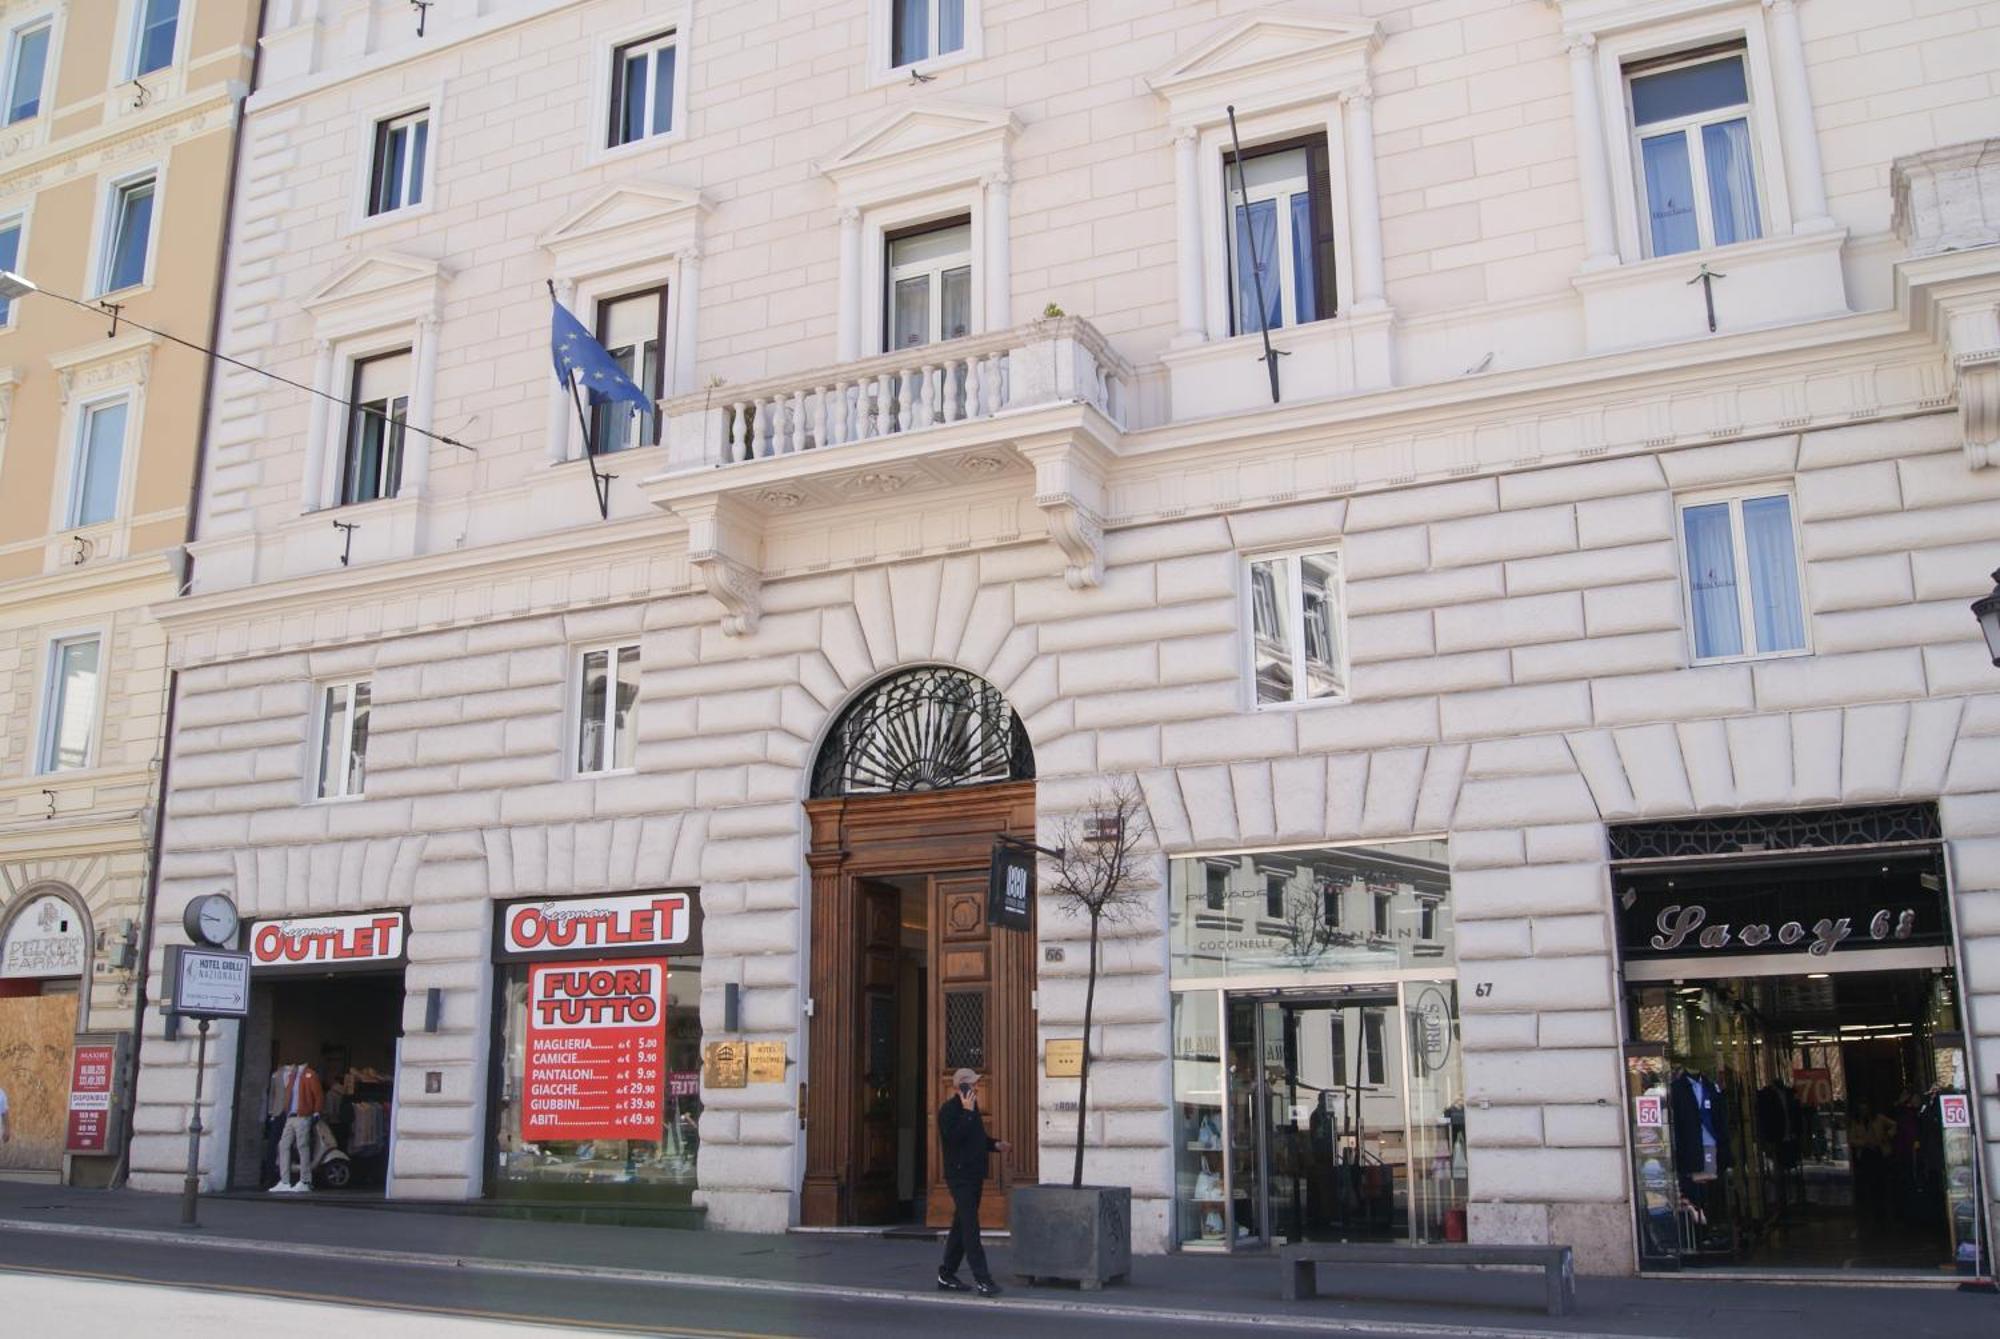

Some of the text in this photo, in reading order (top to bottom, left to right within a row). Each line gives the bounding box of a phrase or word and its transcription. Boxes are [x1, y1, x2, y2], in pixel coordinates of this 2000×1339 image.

[511, 898, 685, 948] OUTLET
[1651, 905, 1916, 957] Savoy 68
[255, 917, 399, 962] OUTLET
[1199, 938, 1274, 951] COCCINELLE
[199, 959, 220, 969] HOTEL
[543, 969, 652, 998] FUORI
[1475, 982, 1493, 997] 67
[537, 996, 657, 1025] TUTTO
[638, 1037, 657, 1049] 5.00
[638, 1052, 657, 1063] 9.90
[637, 1067, 656, 1079] 9.90
[630, 1083, 655, 1094] 29.90
[630, 1098, 655, 1109] 39.90
[630, 1113, 655, 1124] 49.90
[1641, 1107, 1657, 1122] 50
[1946, 1107, 1965, 1122] 50
